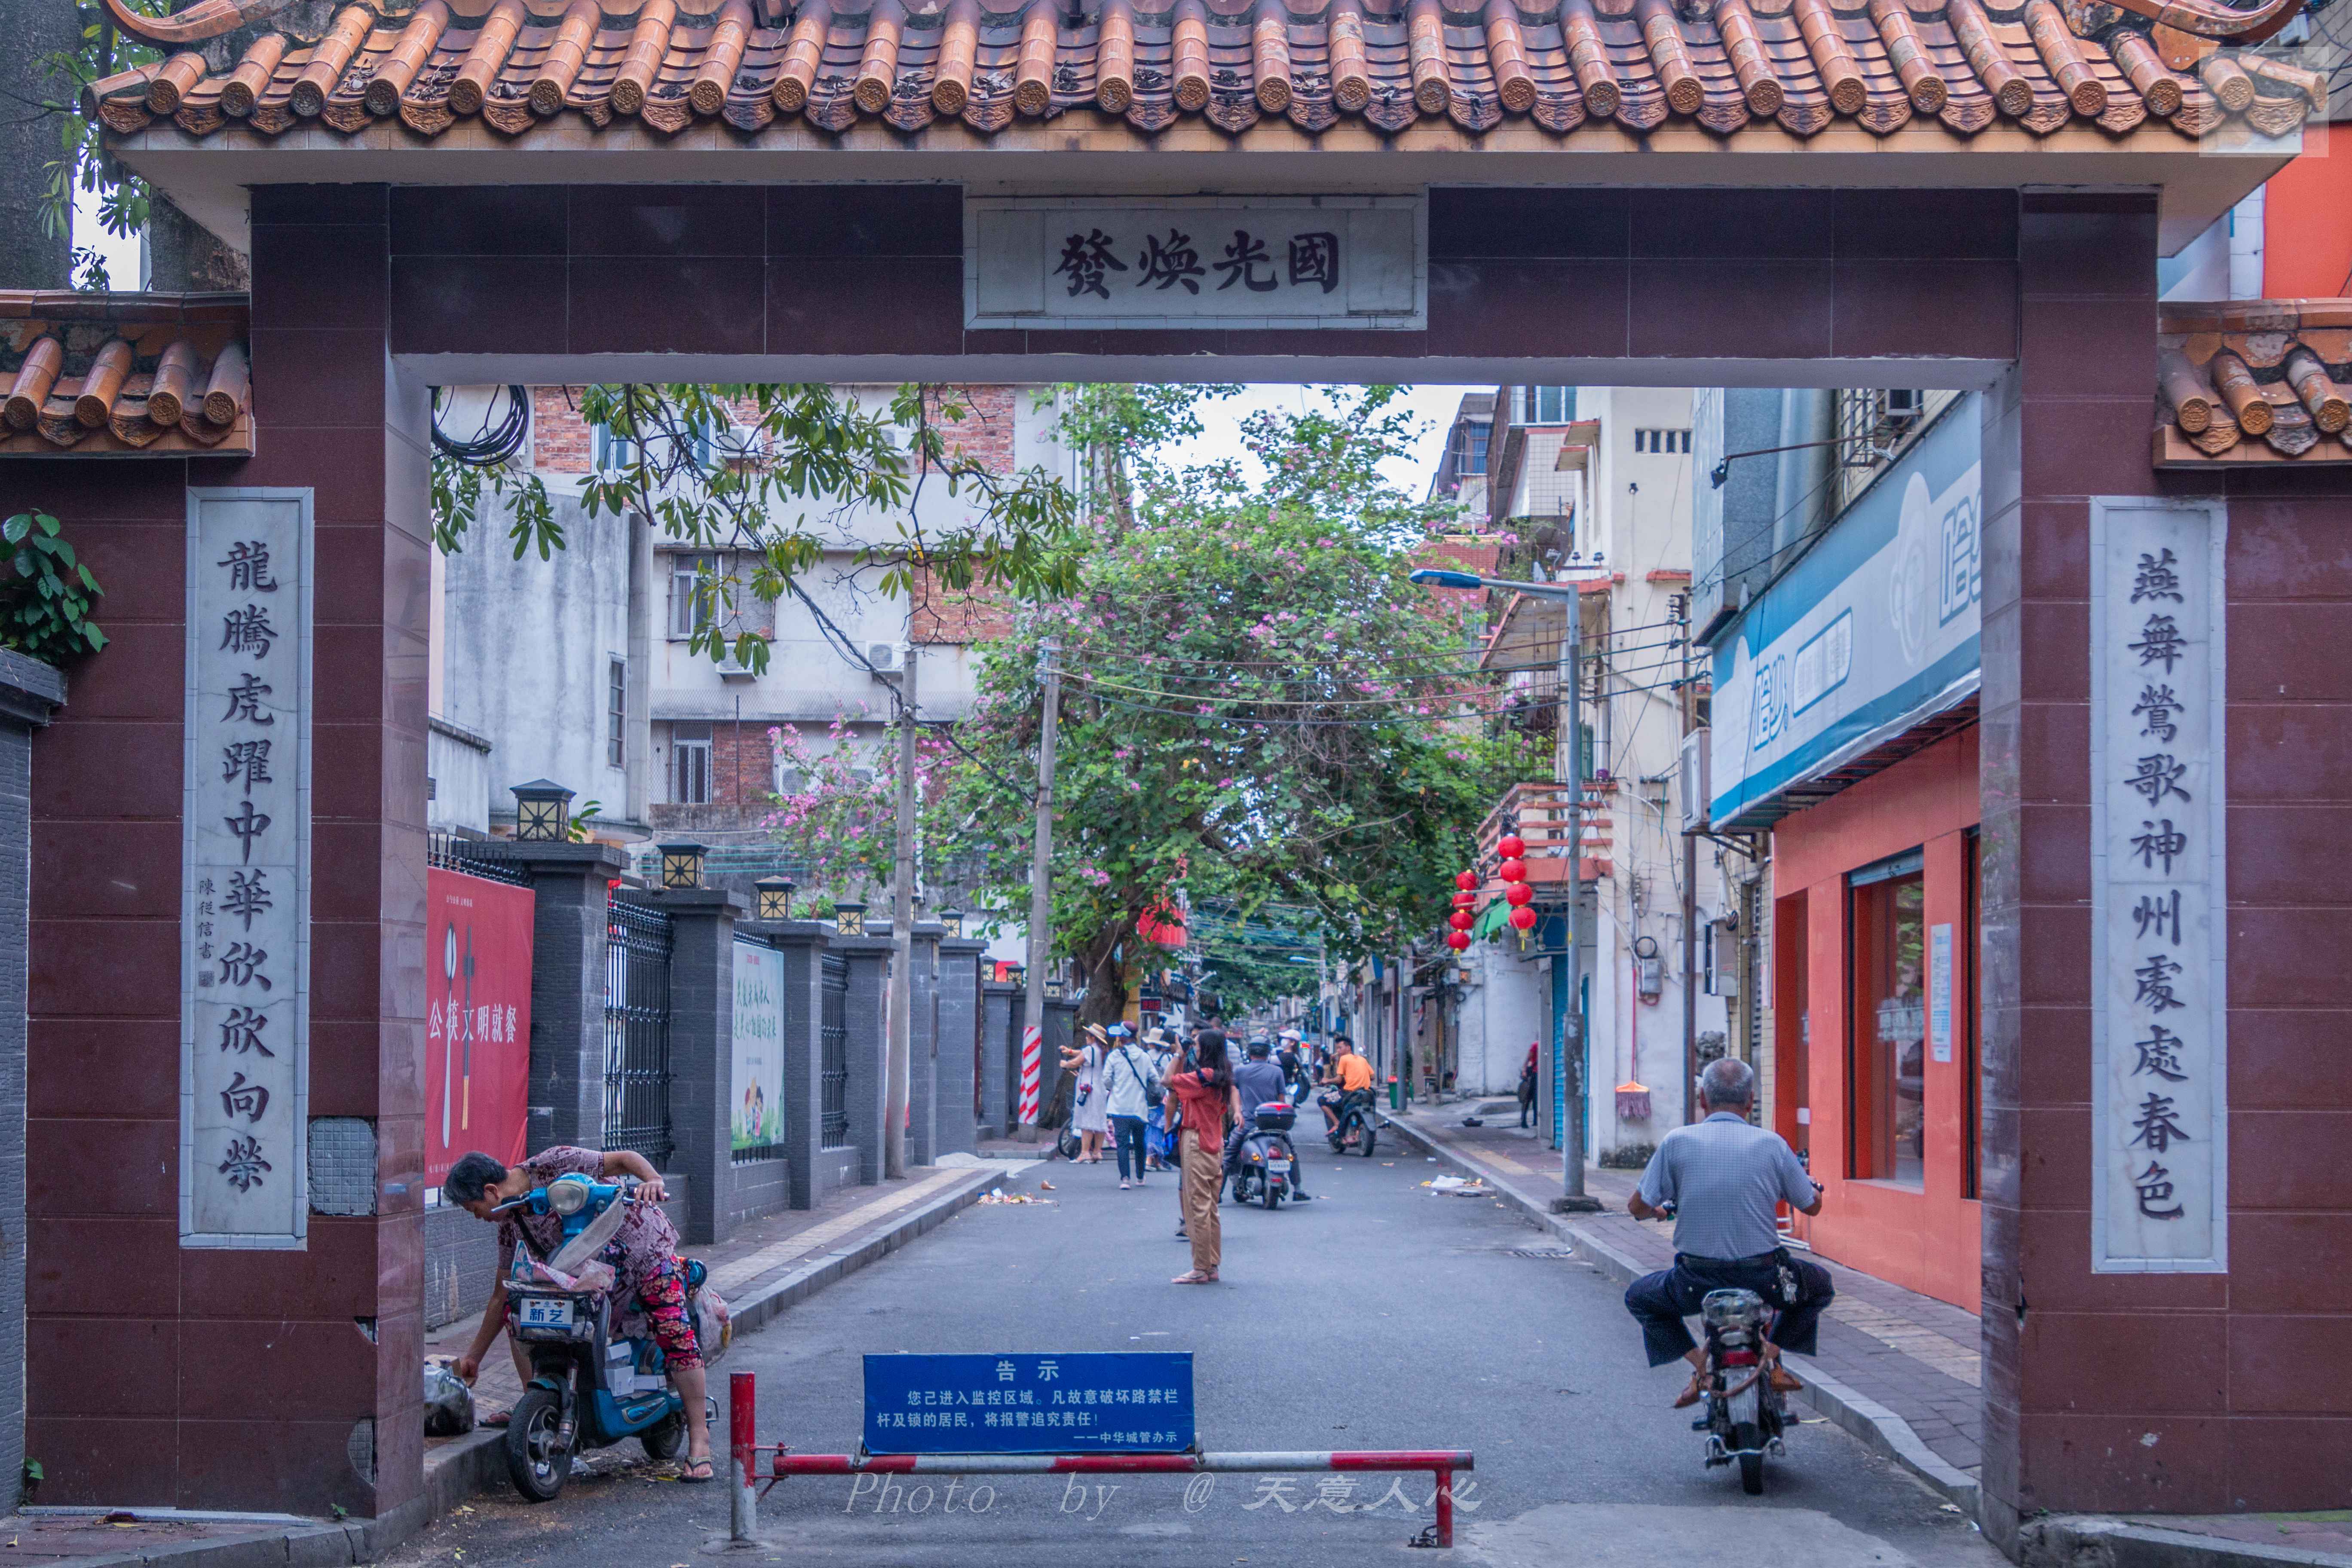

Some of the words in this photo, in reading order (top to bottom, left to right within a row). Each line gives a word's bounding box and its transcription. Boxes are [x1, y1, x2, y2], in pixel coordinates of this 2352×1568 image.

[217, 540, 279, 1193] 龍騰虎躍中華欣欣向榮
[530, 1308, 564, 1323] 新艺
